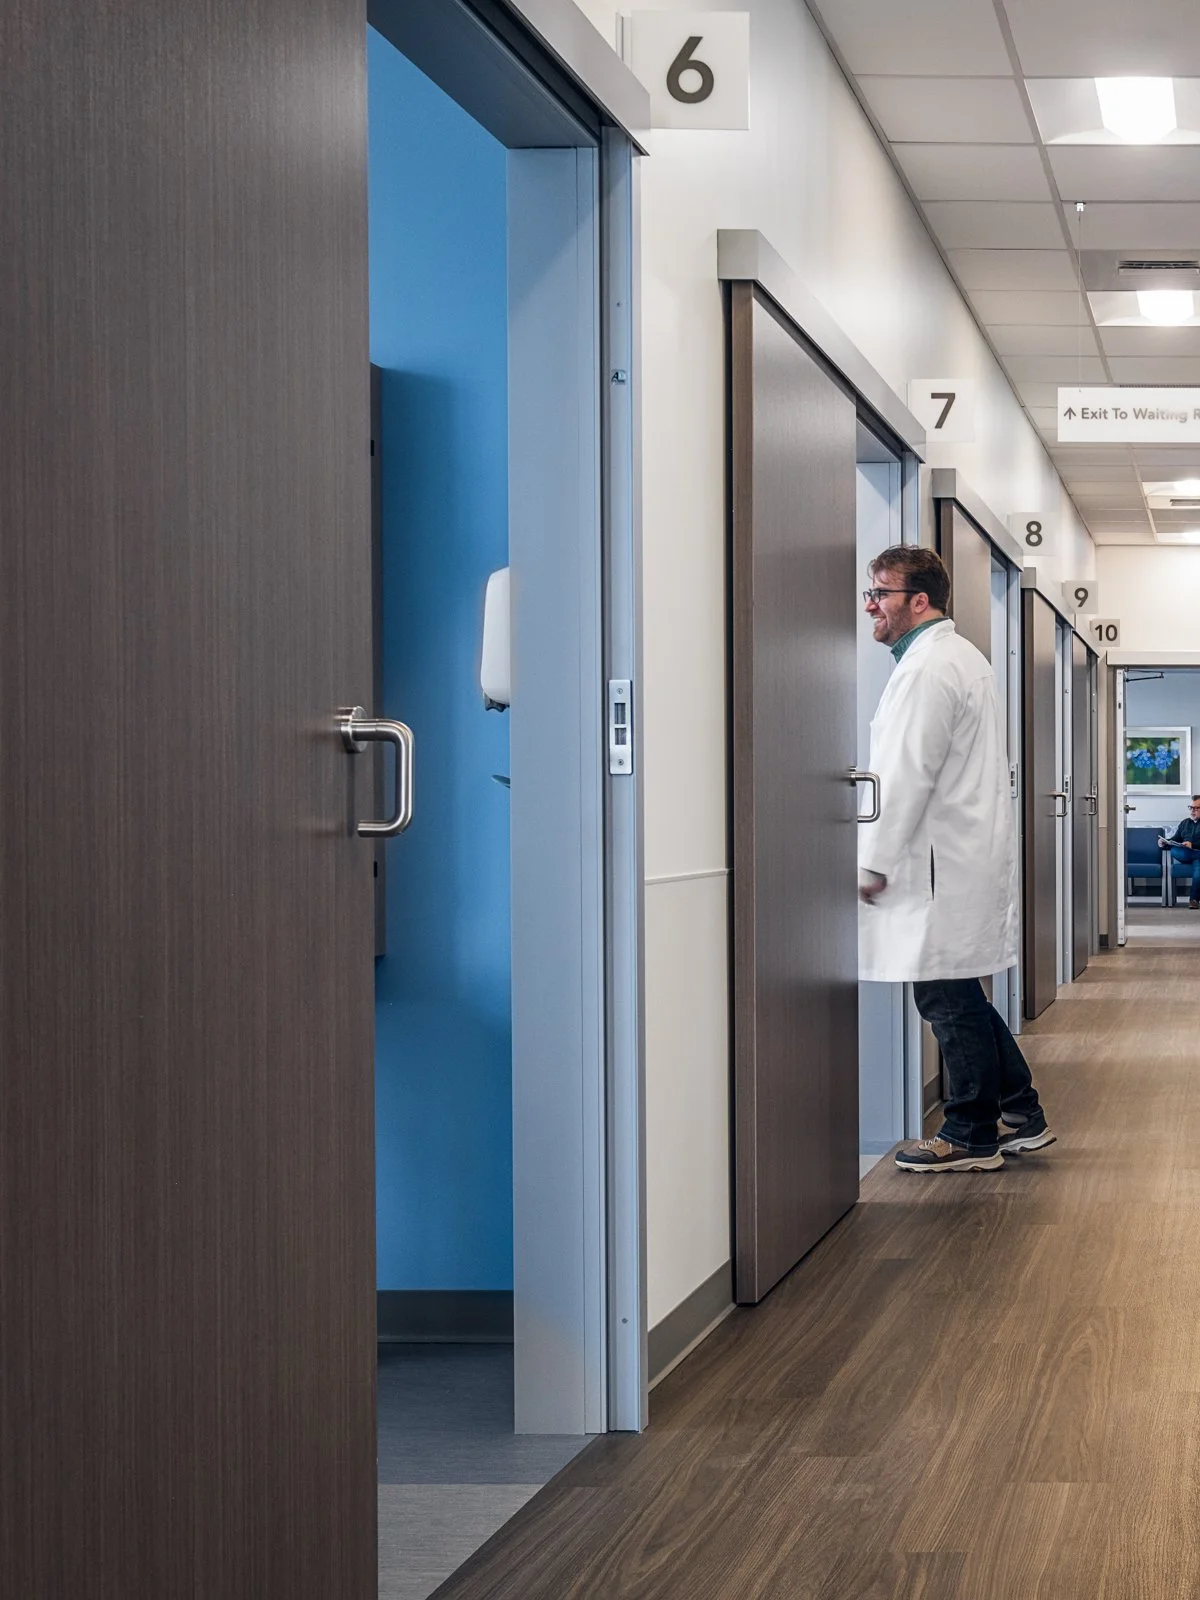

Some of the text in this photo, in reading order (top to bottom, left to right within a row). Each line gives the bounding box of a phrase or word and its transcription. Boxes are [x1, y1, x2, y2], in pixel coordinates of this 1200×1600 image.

[666, 36, 715, 104] 6
[930, 392, 957, 429] 7
[1081, 407, 1108, 420] Exit
[1112, 407, 1128, 420] To
[1133, 407, 1188, 423] Waiting
[1025, 520, 1043, 547] 8
[1074, 587, 1089, 608] 9
[1094, 624, 1118, 642] 10
